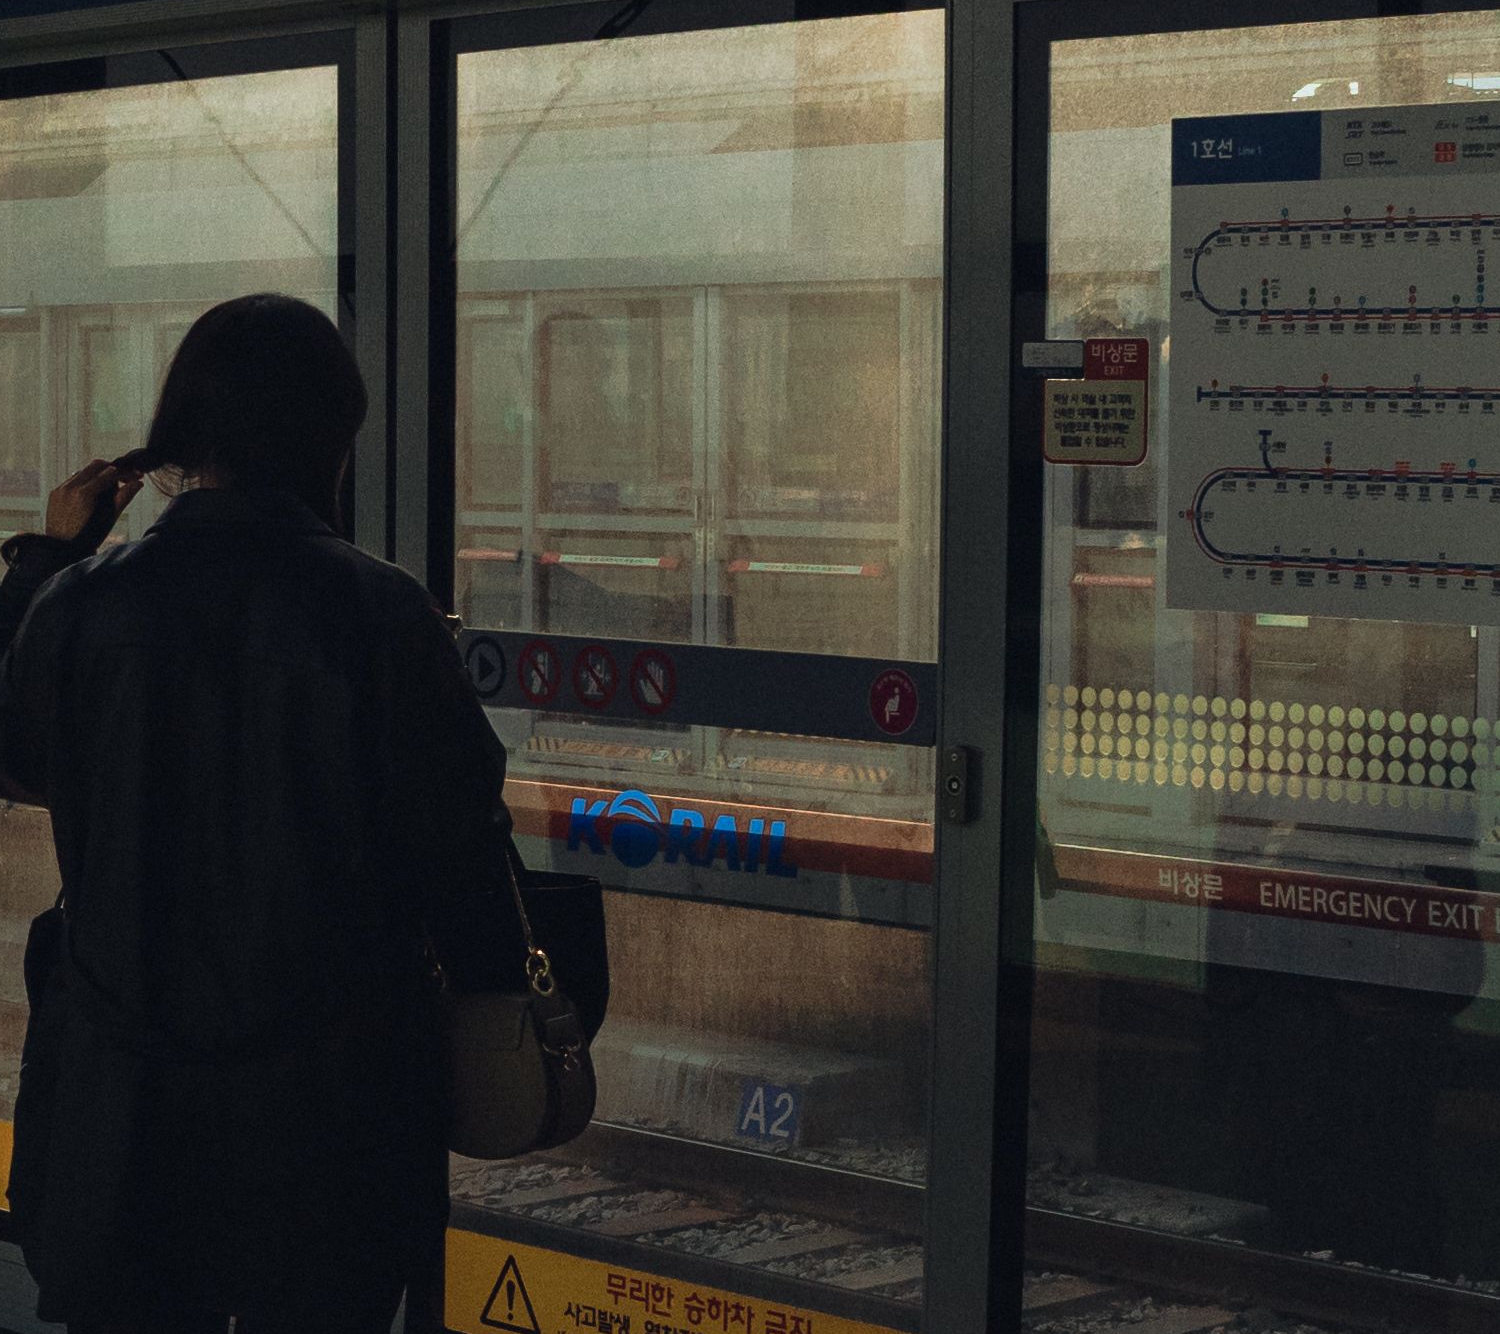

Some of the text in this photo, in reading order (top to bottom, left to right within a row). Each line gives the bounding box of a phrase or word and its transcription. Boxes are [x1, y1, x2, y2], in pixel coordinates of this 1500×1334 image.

[1191, 138, 1233, 160] 1호선
[1091, 343, 1138, 364] 비상문
[1103, 365, 1125, 376] EXIT
[567, 788, 798, 879] KORAIL
[1157, 865, 1225, 902] 비상문
[1258, 879, 1417, 926] EMERGENCY
[1426, 897, 1487, 933] EXIT
[738, 1085, 797, 1140] A2
[605, 1272, 675, 1318] 무리한
